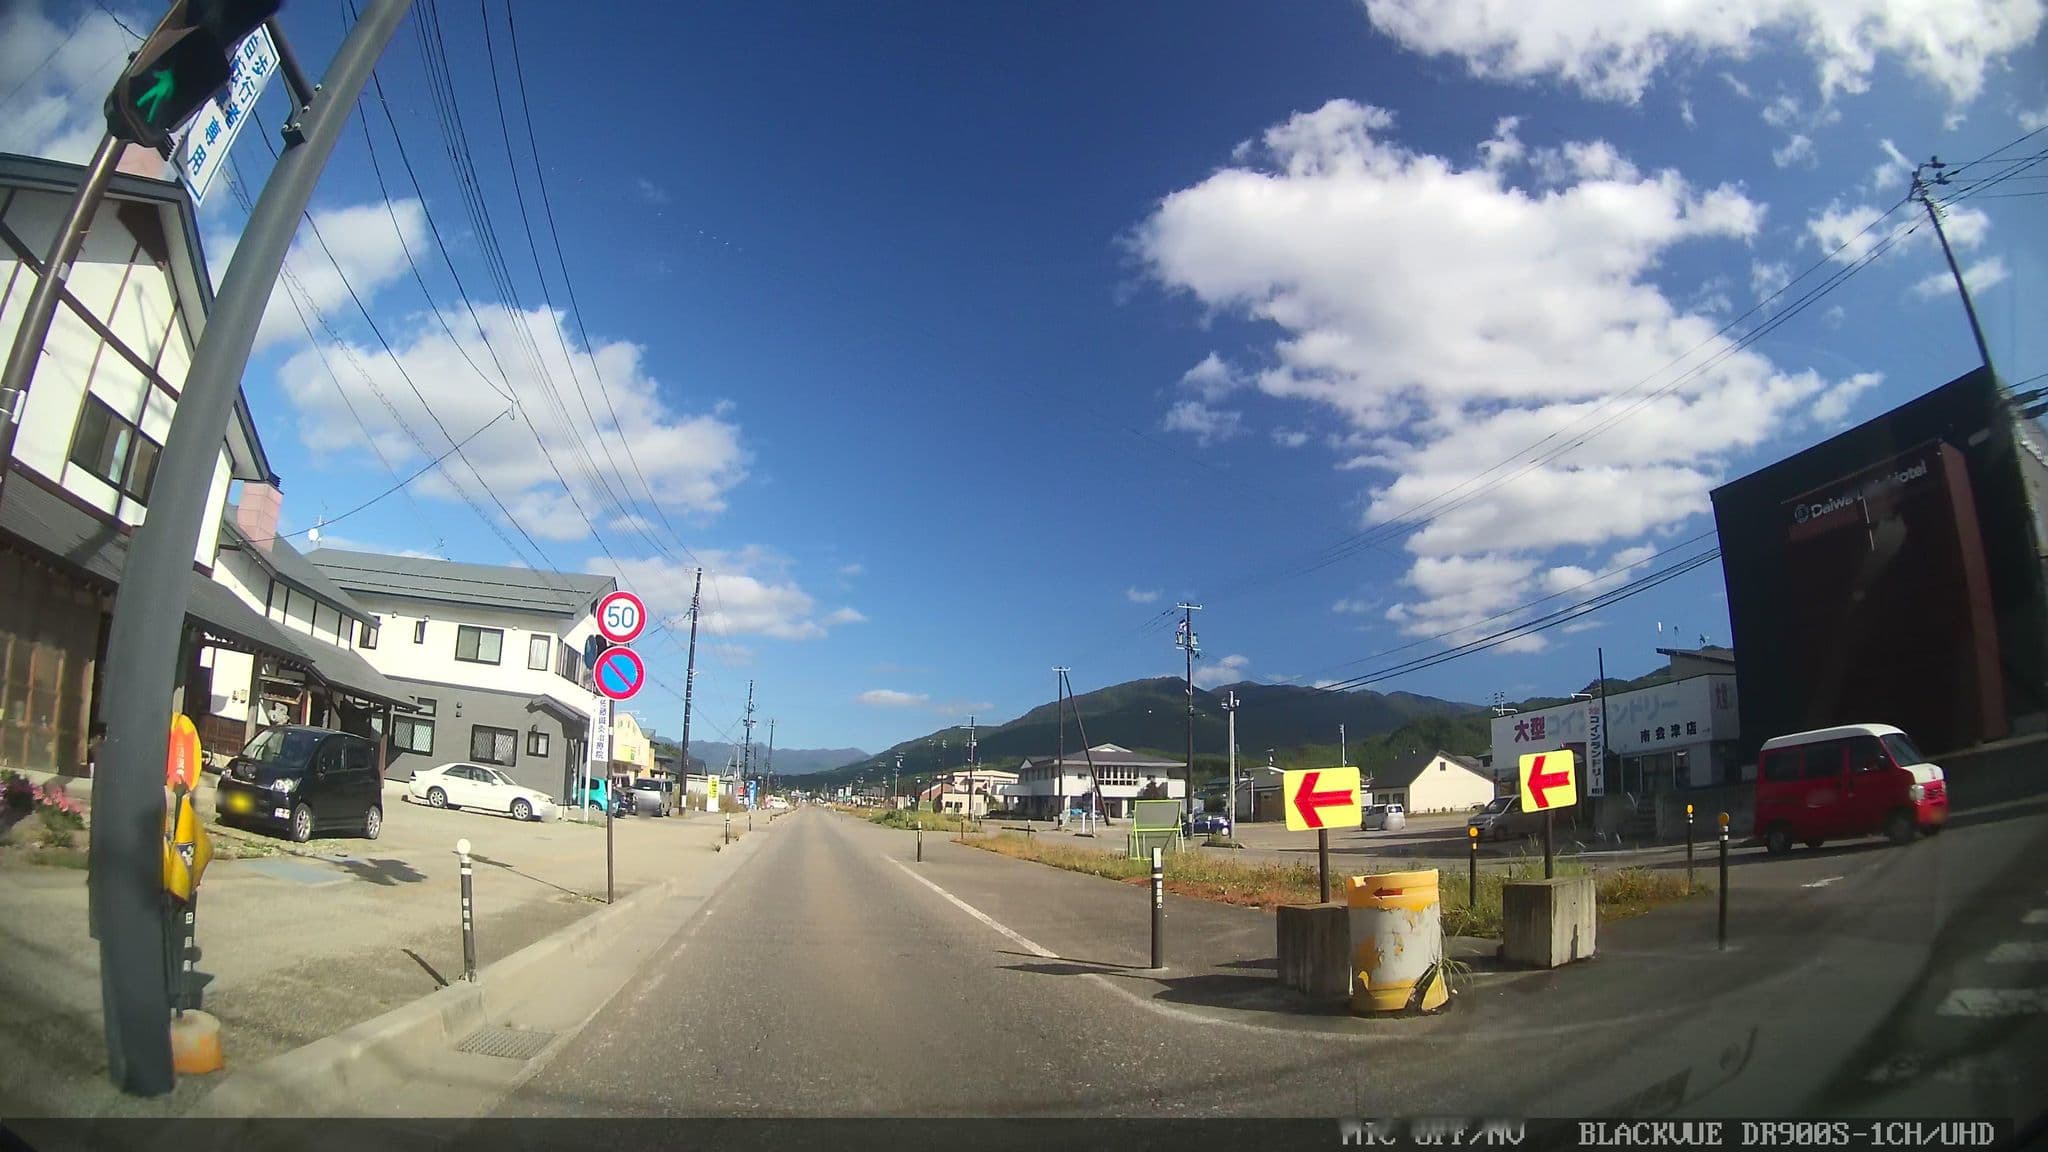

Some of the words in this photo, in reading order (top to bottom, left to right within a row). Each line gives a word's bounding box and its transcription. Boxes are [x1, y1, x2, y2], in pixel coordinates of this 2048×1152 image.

[226, 55, 268, 129] 歩行者
[1810, 497, 1853, 518] Daiwa
[608, 605, 635, 629] 50
[1640, 720, 1697, 743] 南会津店
